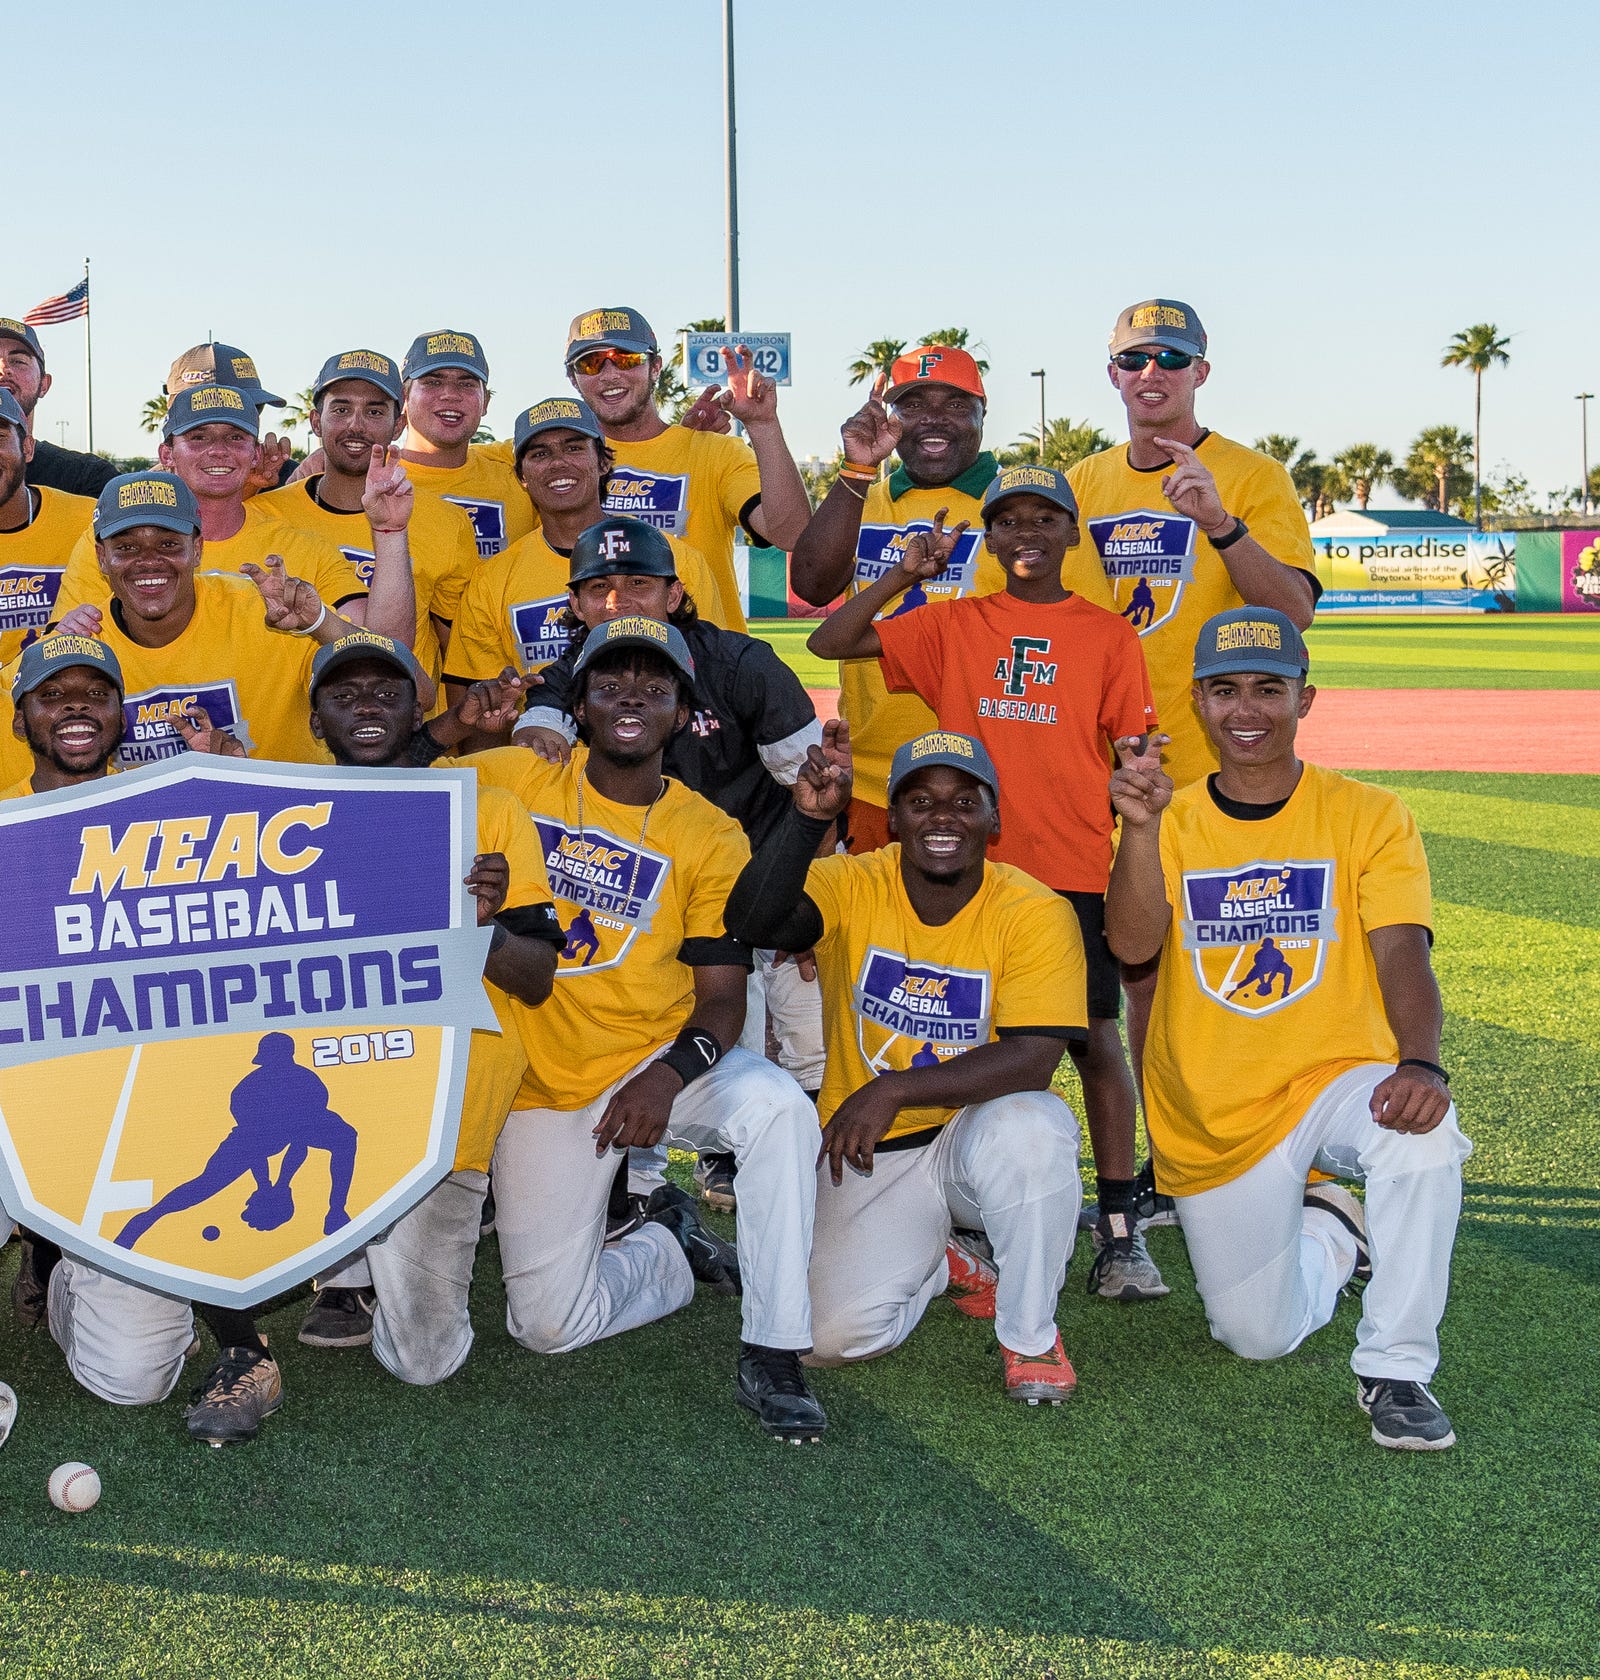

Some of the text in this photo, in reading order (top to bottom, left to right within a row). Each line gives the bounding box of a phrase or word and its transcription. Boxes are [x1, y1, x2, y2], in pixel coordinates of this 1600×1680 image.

[580, 315, 629, 336] CHAMPIONS
[1132, 308, 1186, 329] CHAMPIONS
[427, 339, 475, 356] CHAMPIONS
[692, 336, 785, 345] JACKIE ROBINSON
[338, 355, 388, 374] CHAMPIONS
[707, 351, 778, 373] 9 42
[917, 354, 943, 377] F
[192, 391, 243, 410] CHAMPIONS
[530, 405, 581, 426] CHAMPIONS
[1001, 472, 1056, 490] CHAMPIONS
[118, 488, 177, 508] CHAMPIONS
[602, 497, 656, 509] SEBALL
[1108, 521, 1165, 541] MEAC
[598, 530, 630, 559] AFM
[1104, 539, 1165, 555] BASEBALL
[1325, 537, 1466, 564] to paradise
[1104, 559, 1182, 577] HAMPIONS
[1371, 573, 1455, 583] Daytona Tortugas
[926, 585, 951, 594] 2019
[1150, 579, 1172, 587] 2019
[1359, 593, 1376, 602] and
[1378, 593, 1417, 604] beyond.
[607, 621, 667, 642] CHAMPIONS
[1217, 628, 1282, 651] CHAMPIONS
[43, 639, 105, 660] CHAMPIONS
[994, 636, 1057, 696] AFM
[978, 698, 1057, 724] BASEBALL
[120, 741, 187, 761] CHAMP
[911, 738, 973, 760] CHAMPIONS
[69, 802, 333, 900] MEAC
[556, 834, 628, 870] MEAC
[546, 851, 623, 889] BASEBALL
[548, 874, 641, 918] AMPIONS
[54, 880, 355, 955] BASEBALL
[594, 915, 624, 930] 2019
[1197, 914, 1320, 941] CHAMIONS
[1280, 940, 1310, 949] 2019
[900, 975, 949, 998] EAC
[889, 987, 951, 1016] BAEBALL
[861, 997, 977, 1040] CHAMPIONS
[312, 1030, 415, 1067] 2019
[937, 1046, 968, 1056] 2019
